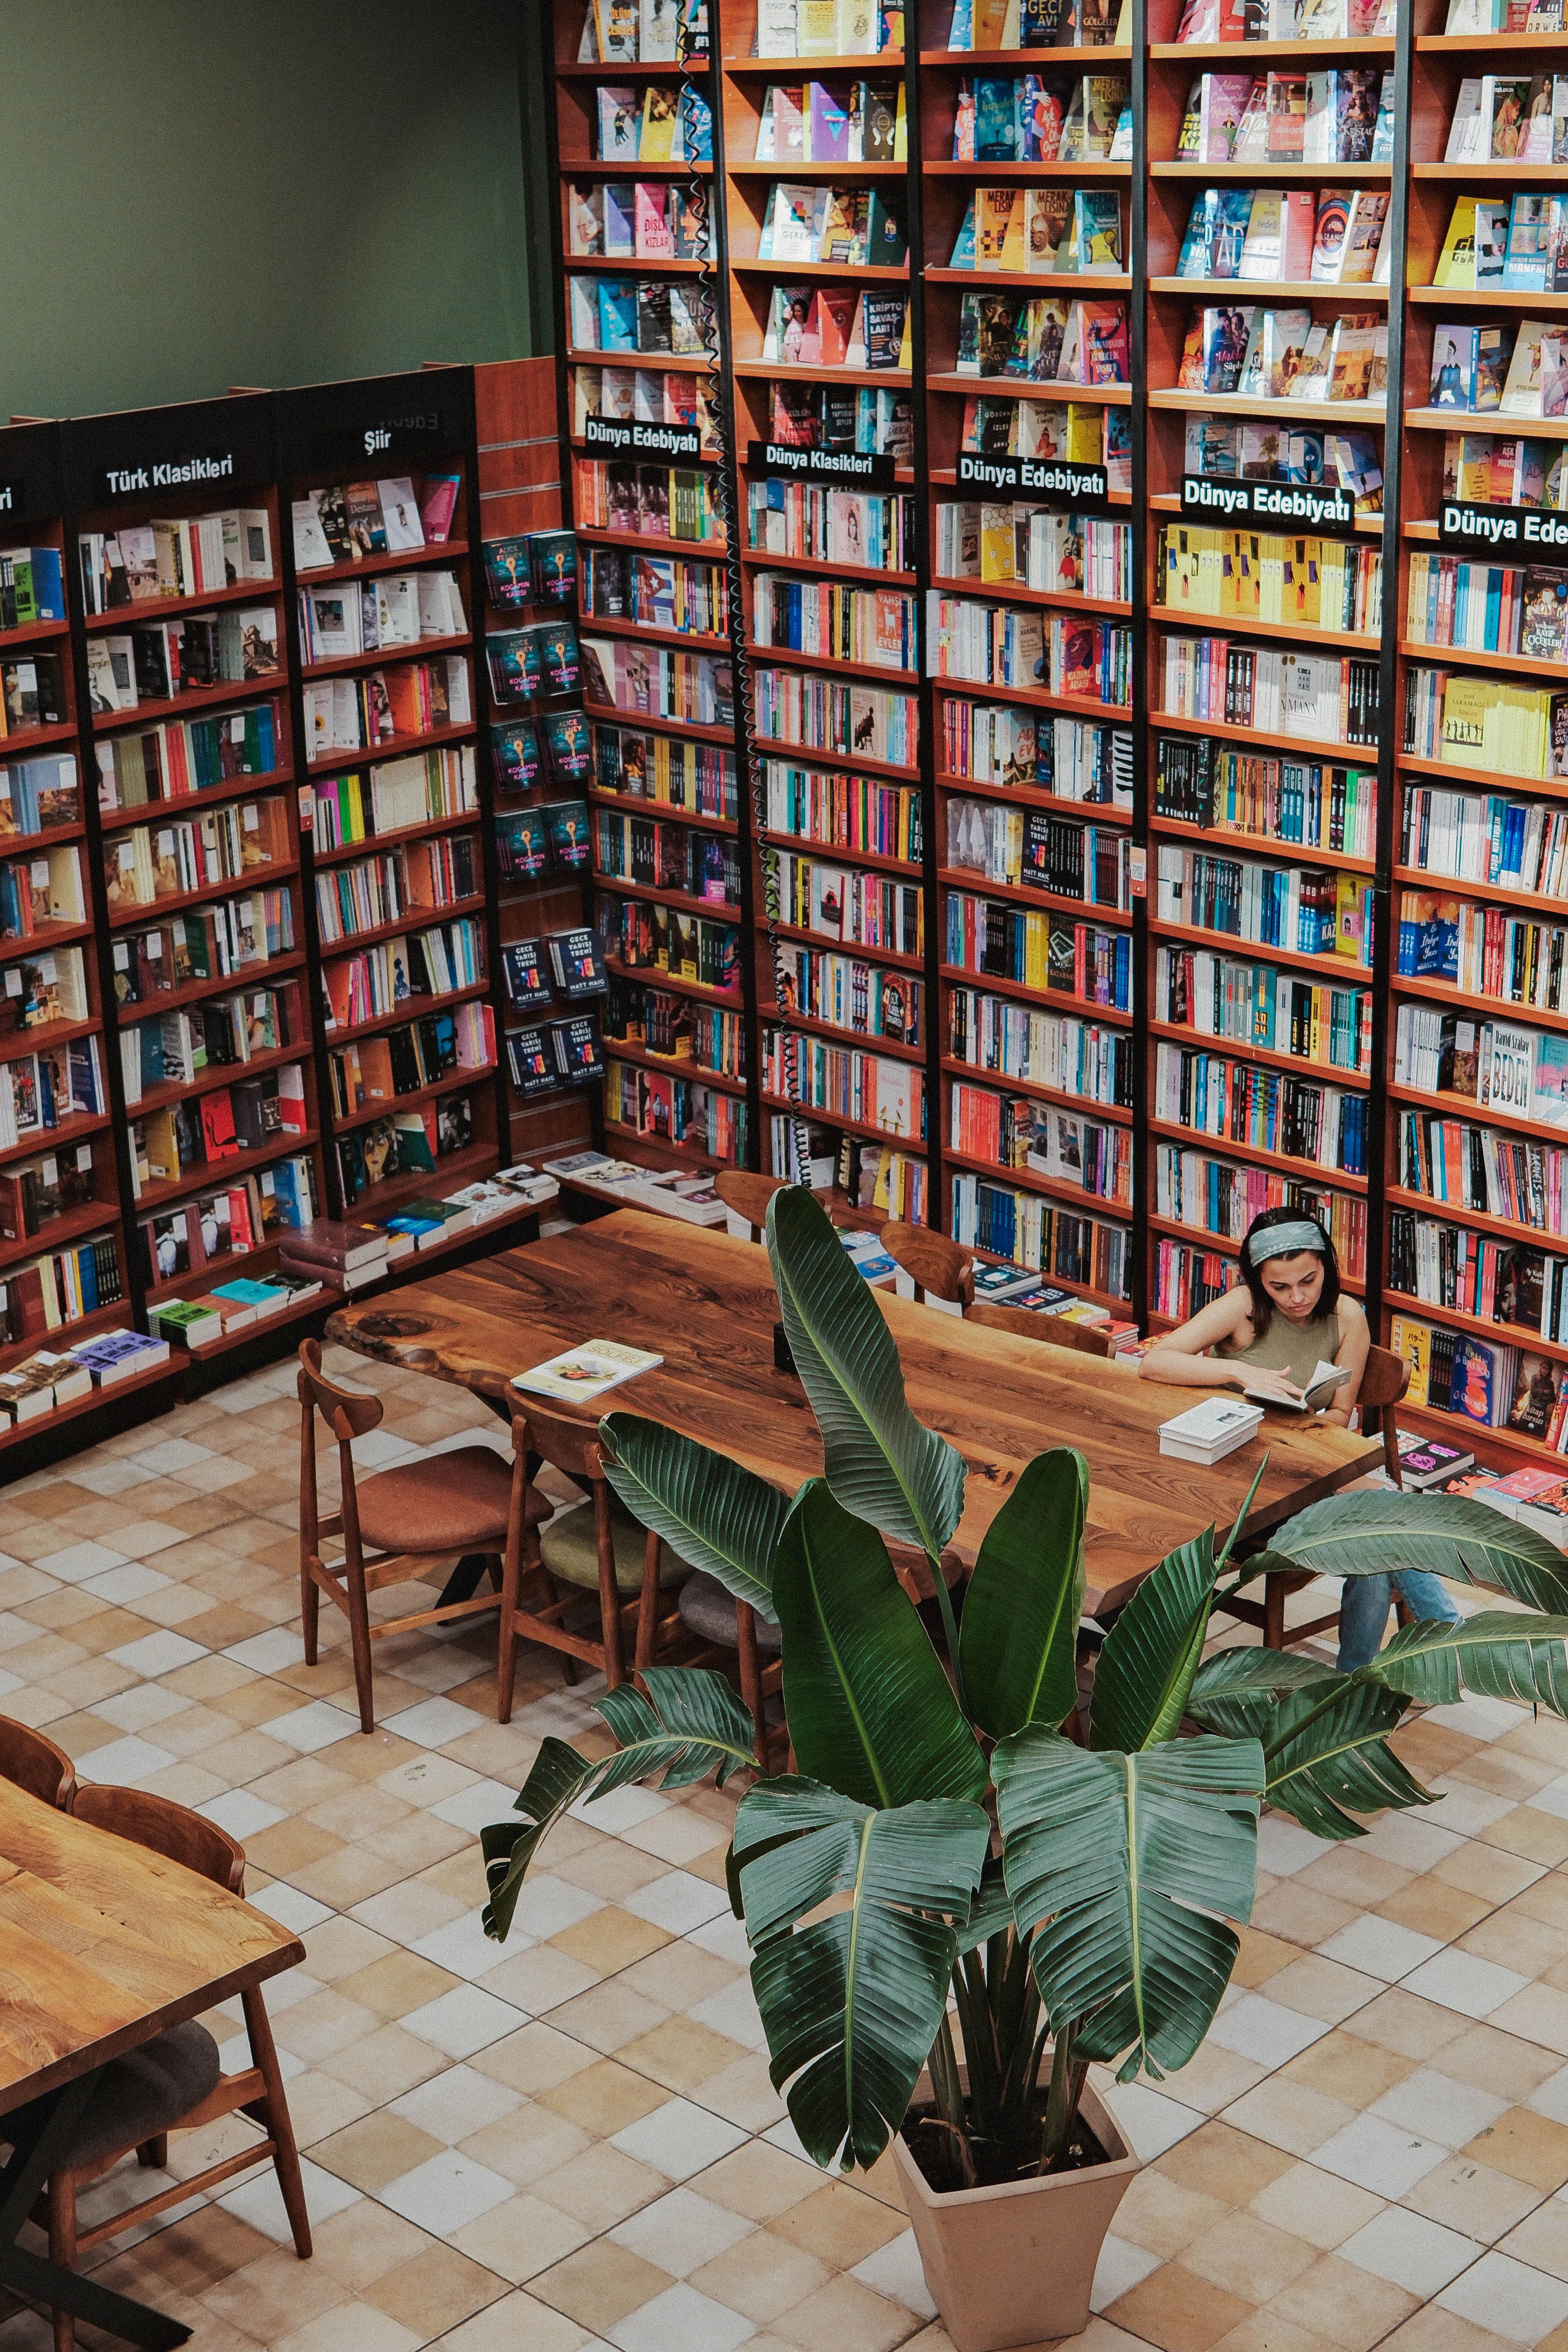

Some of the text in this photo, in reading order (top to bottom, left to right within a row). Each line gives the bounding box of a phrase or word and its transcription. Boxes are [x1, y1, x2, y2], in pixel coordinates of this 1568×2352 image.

[869, 303, 902, 312] KRİPTO
[870, 324, 889, 334] LARI
[364, 429, 392, 455] Şiir
[587, 421, 698, 454] Dünya Edebiyatı
[766, 446, 873, 473] Dünya Klasikleri
[107, 454, 233, 493] Türk Klasikleri
[961, 458, 1104, 496] Dünya Edebiyatı
[1185, 480, 1350, 523] Dünya Edebiyatı
[1445, 508, 1517, 543] Dünya
[1032, 816, 1047, 825] GECE
[1030, 823, 1048, 833] YARISI
[1023, 868, 1036, 877] MATT
[570, 934, 588, 943] GECE
[516, 946, 533, 954] GECE
[568, 941, 591, 950] YARISI
[515, 952, 537, 961] YARISI
[570, 979, 605, 991] MATT HAIG
[517, 992, 533, 1001] MATT
[571, 1021, 588, 1029] GECE
[521, 1032, 537, 1041] GECE
[570, 1027, 591, 1036] YARISI
[521, 1038, 541, 1048] YARISI
[1495, 1030, 1529, 1055] David Szalay
[573, 1064, 603, 1076] MATT HAIG
[525, 1079, 539, 1087] MATT
[1492, 1051, 1528, 1108] BEDEN
[587, 1344, 642, 1366] SOLFEJ
